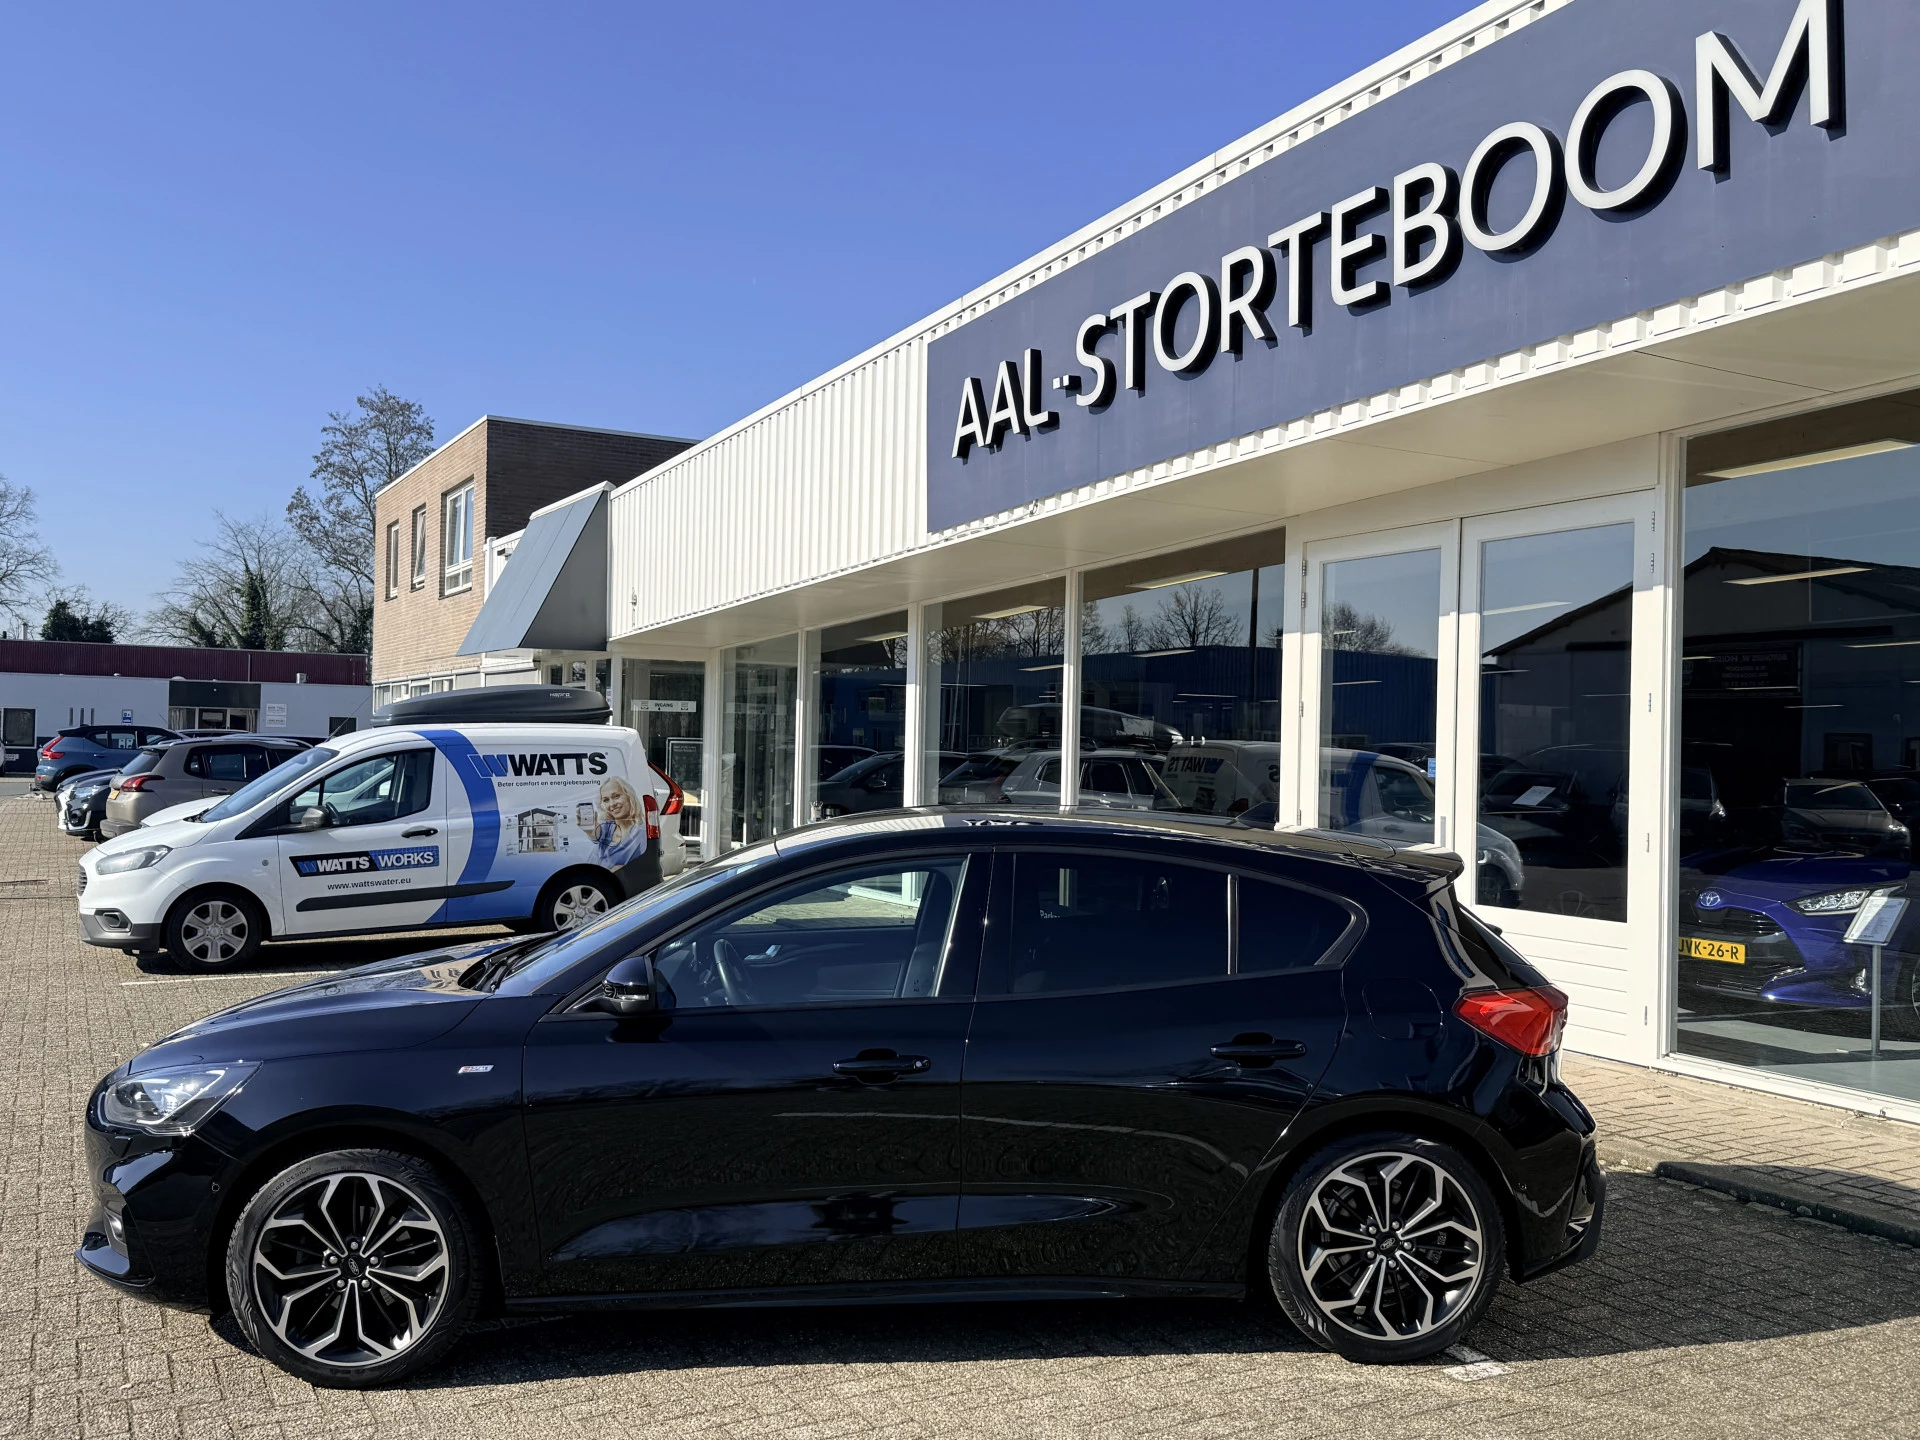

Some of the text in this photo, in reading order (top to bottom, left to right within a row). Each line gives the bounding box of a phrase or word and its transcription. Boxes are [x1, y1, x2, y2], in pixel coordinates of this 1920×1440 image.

[507, 752, 608, 776] WATTS
[550, 779, 601, 787] energiebesparing
[317, 851, 434, 872] WATTS WORKS
[327, 877, 411, 890] www.wattswater.eu
